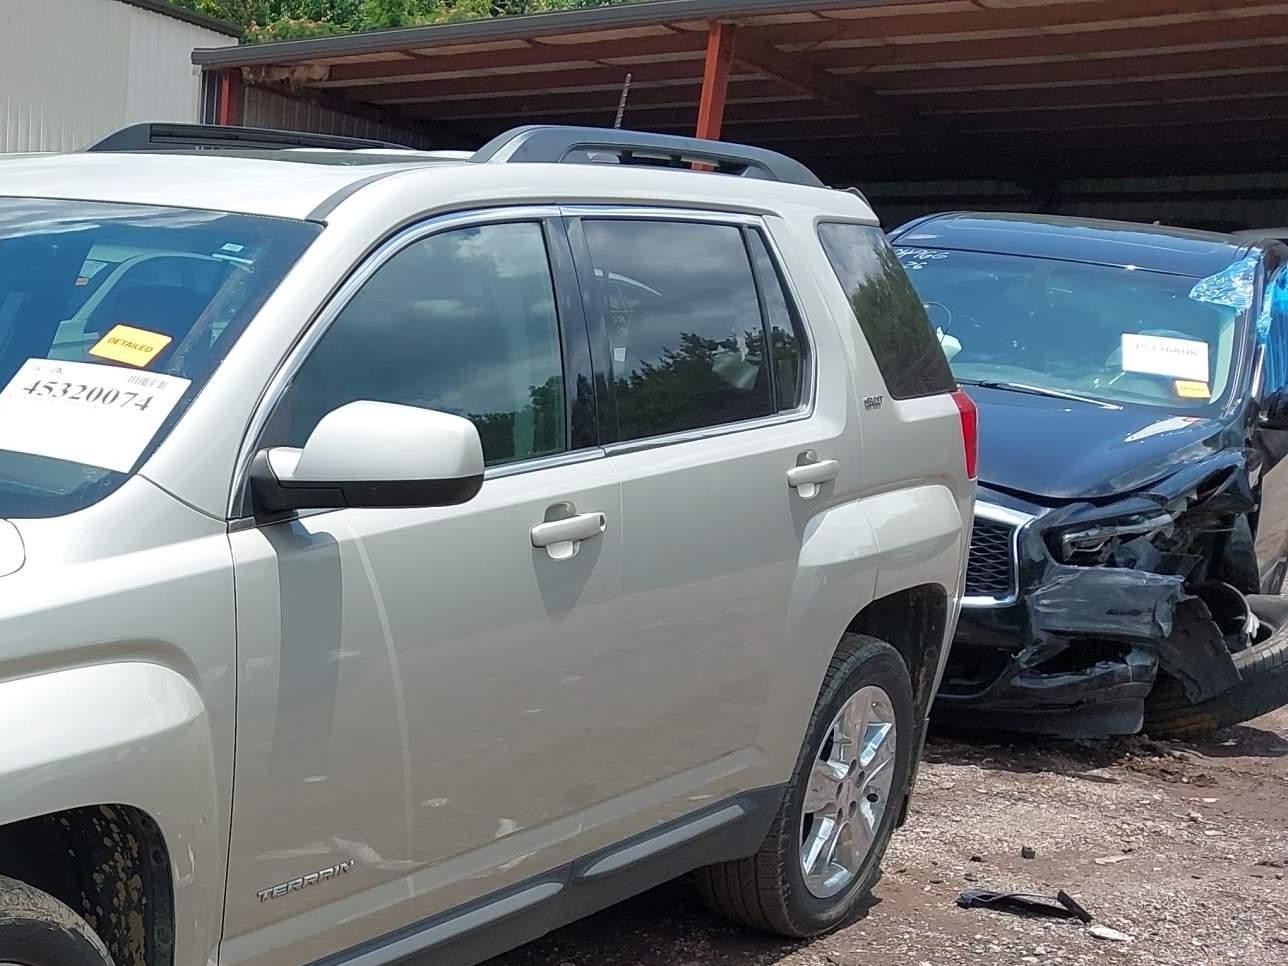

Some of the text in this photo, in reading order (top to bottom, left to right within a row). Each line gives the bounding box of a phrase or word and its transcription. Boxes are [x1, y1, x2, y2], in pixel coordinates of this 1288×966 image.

[107, 337, 154, 353] DETAILED
[23, 379, 154, 411] 45320074
[256, 858, 355, 902] TERRAIN
